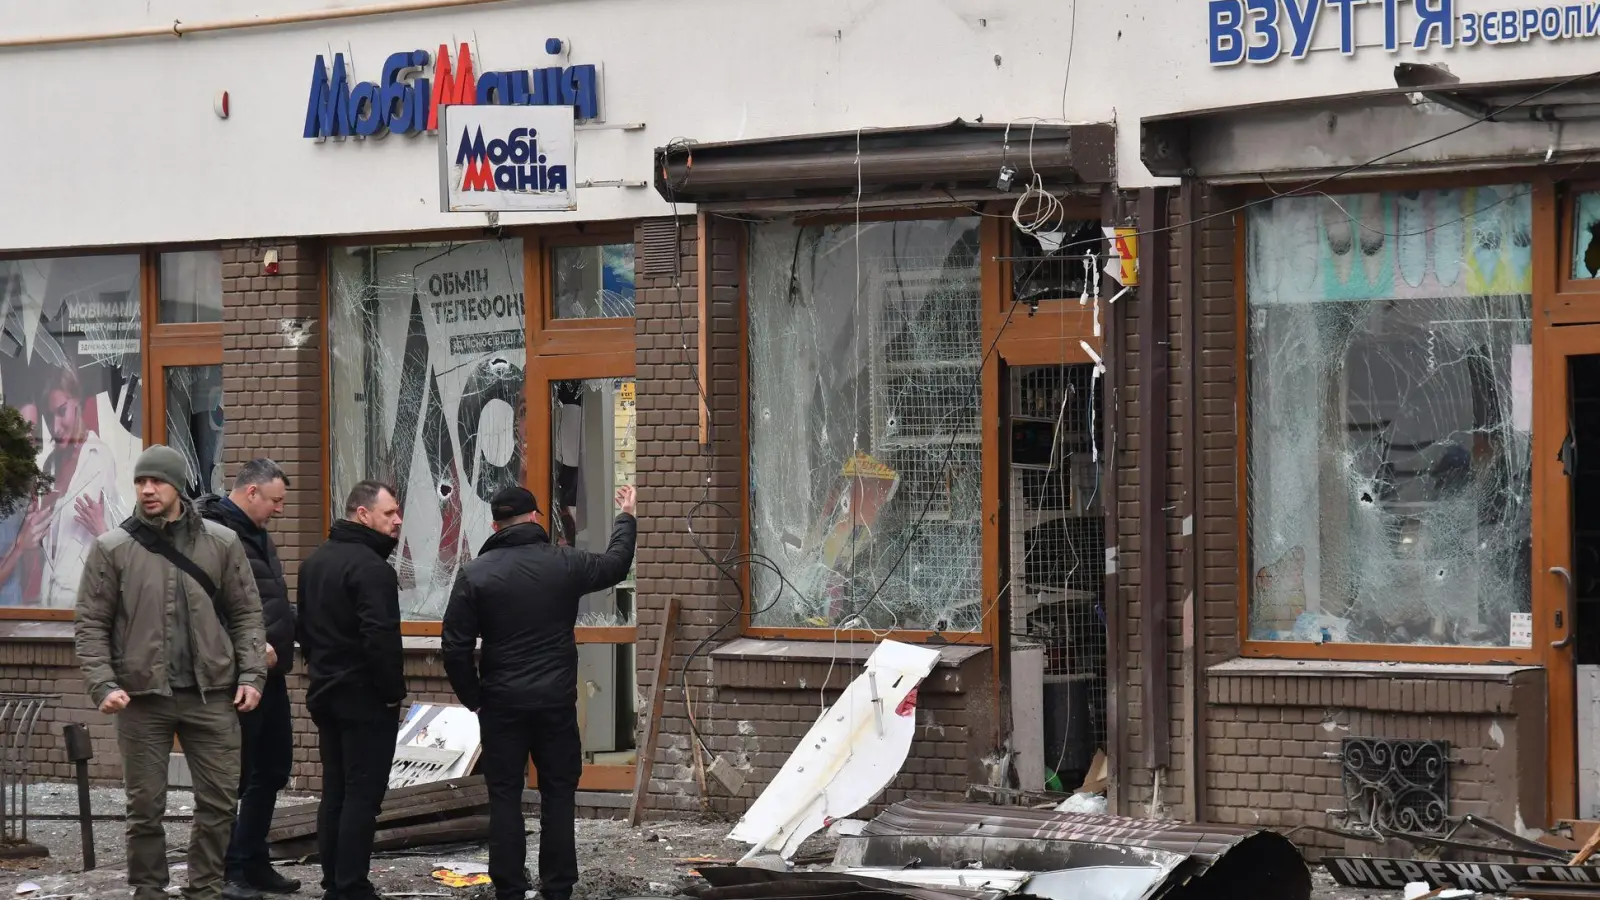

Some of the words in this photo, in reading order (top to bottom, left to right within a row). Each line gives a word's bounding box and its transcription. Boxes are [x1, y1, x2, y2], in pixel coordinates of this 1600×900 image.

[1209, 0, 1453, 63] ВЗУТТЯ
[461, 153, 567, 192] Манія
[429, 268, 489, 297] ОБМІН
[1335, 857, 1517, 891] МЕРЕЖА
